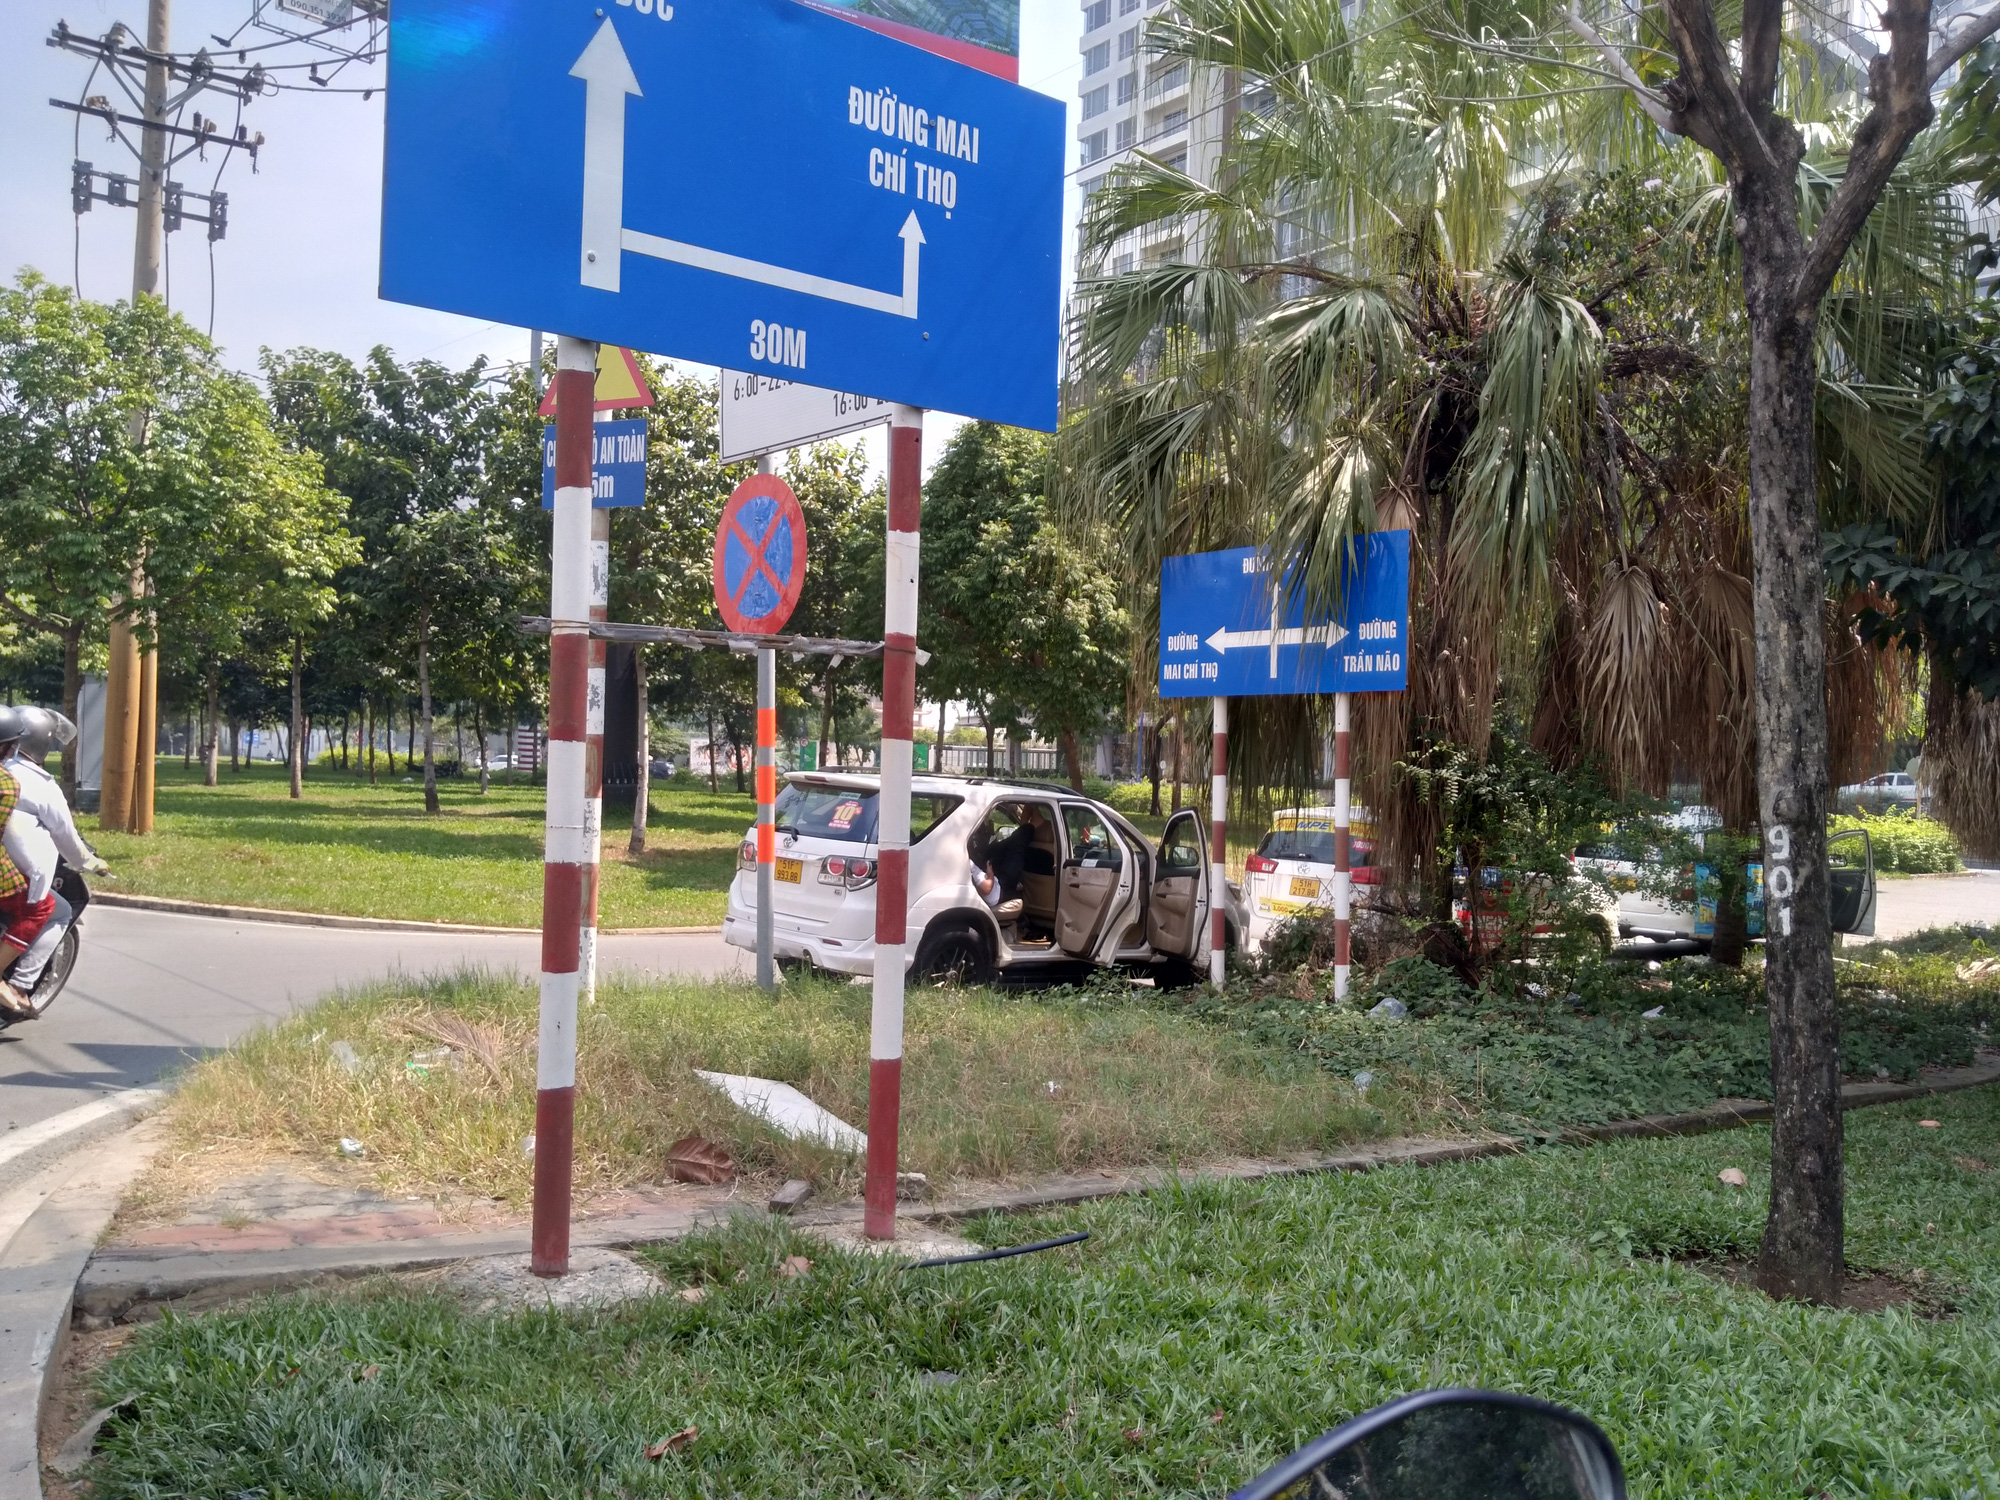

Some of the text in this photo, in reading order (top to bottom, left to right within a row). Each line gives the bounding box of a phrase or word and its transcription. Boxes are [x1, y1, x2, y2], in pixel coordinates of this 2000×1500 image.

[848, 85, 979, 164] ĐƯỜNG MAI
[869, 147, 957, 220] CHÍ THỌ
[749, 319, 807, 370] 30M
[600, 436, 615, 465] AN
[617, 428, 645, 463] TOÀN
[1167, 630, 1199, 651] ĐƯỜNG
[1358, 617, 1397, 640] ĐƯỜNG
[1163, 659, 1218, 682] MAI CHÍ THỌ
[1343, 649, 1400, 673] TRẦN NÃO
[782, 860, 794, 870] 51F
